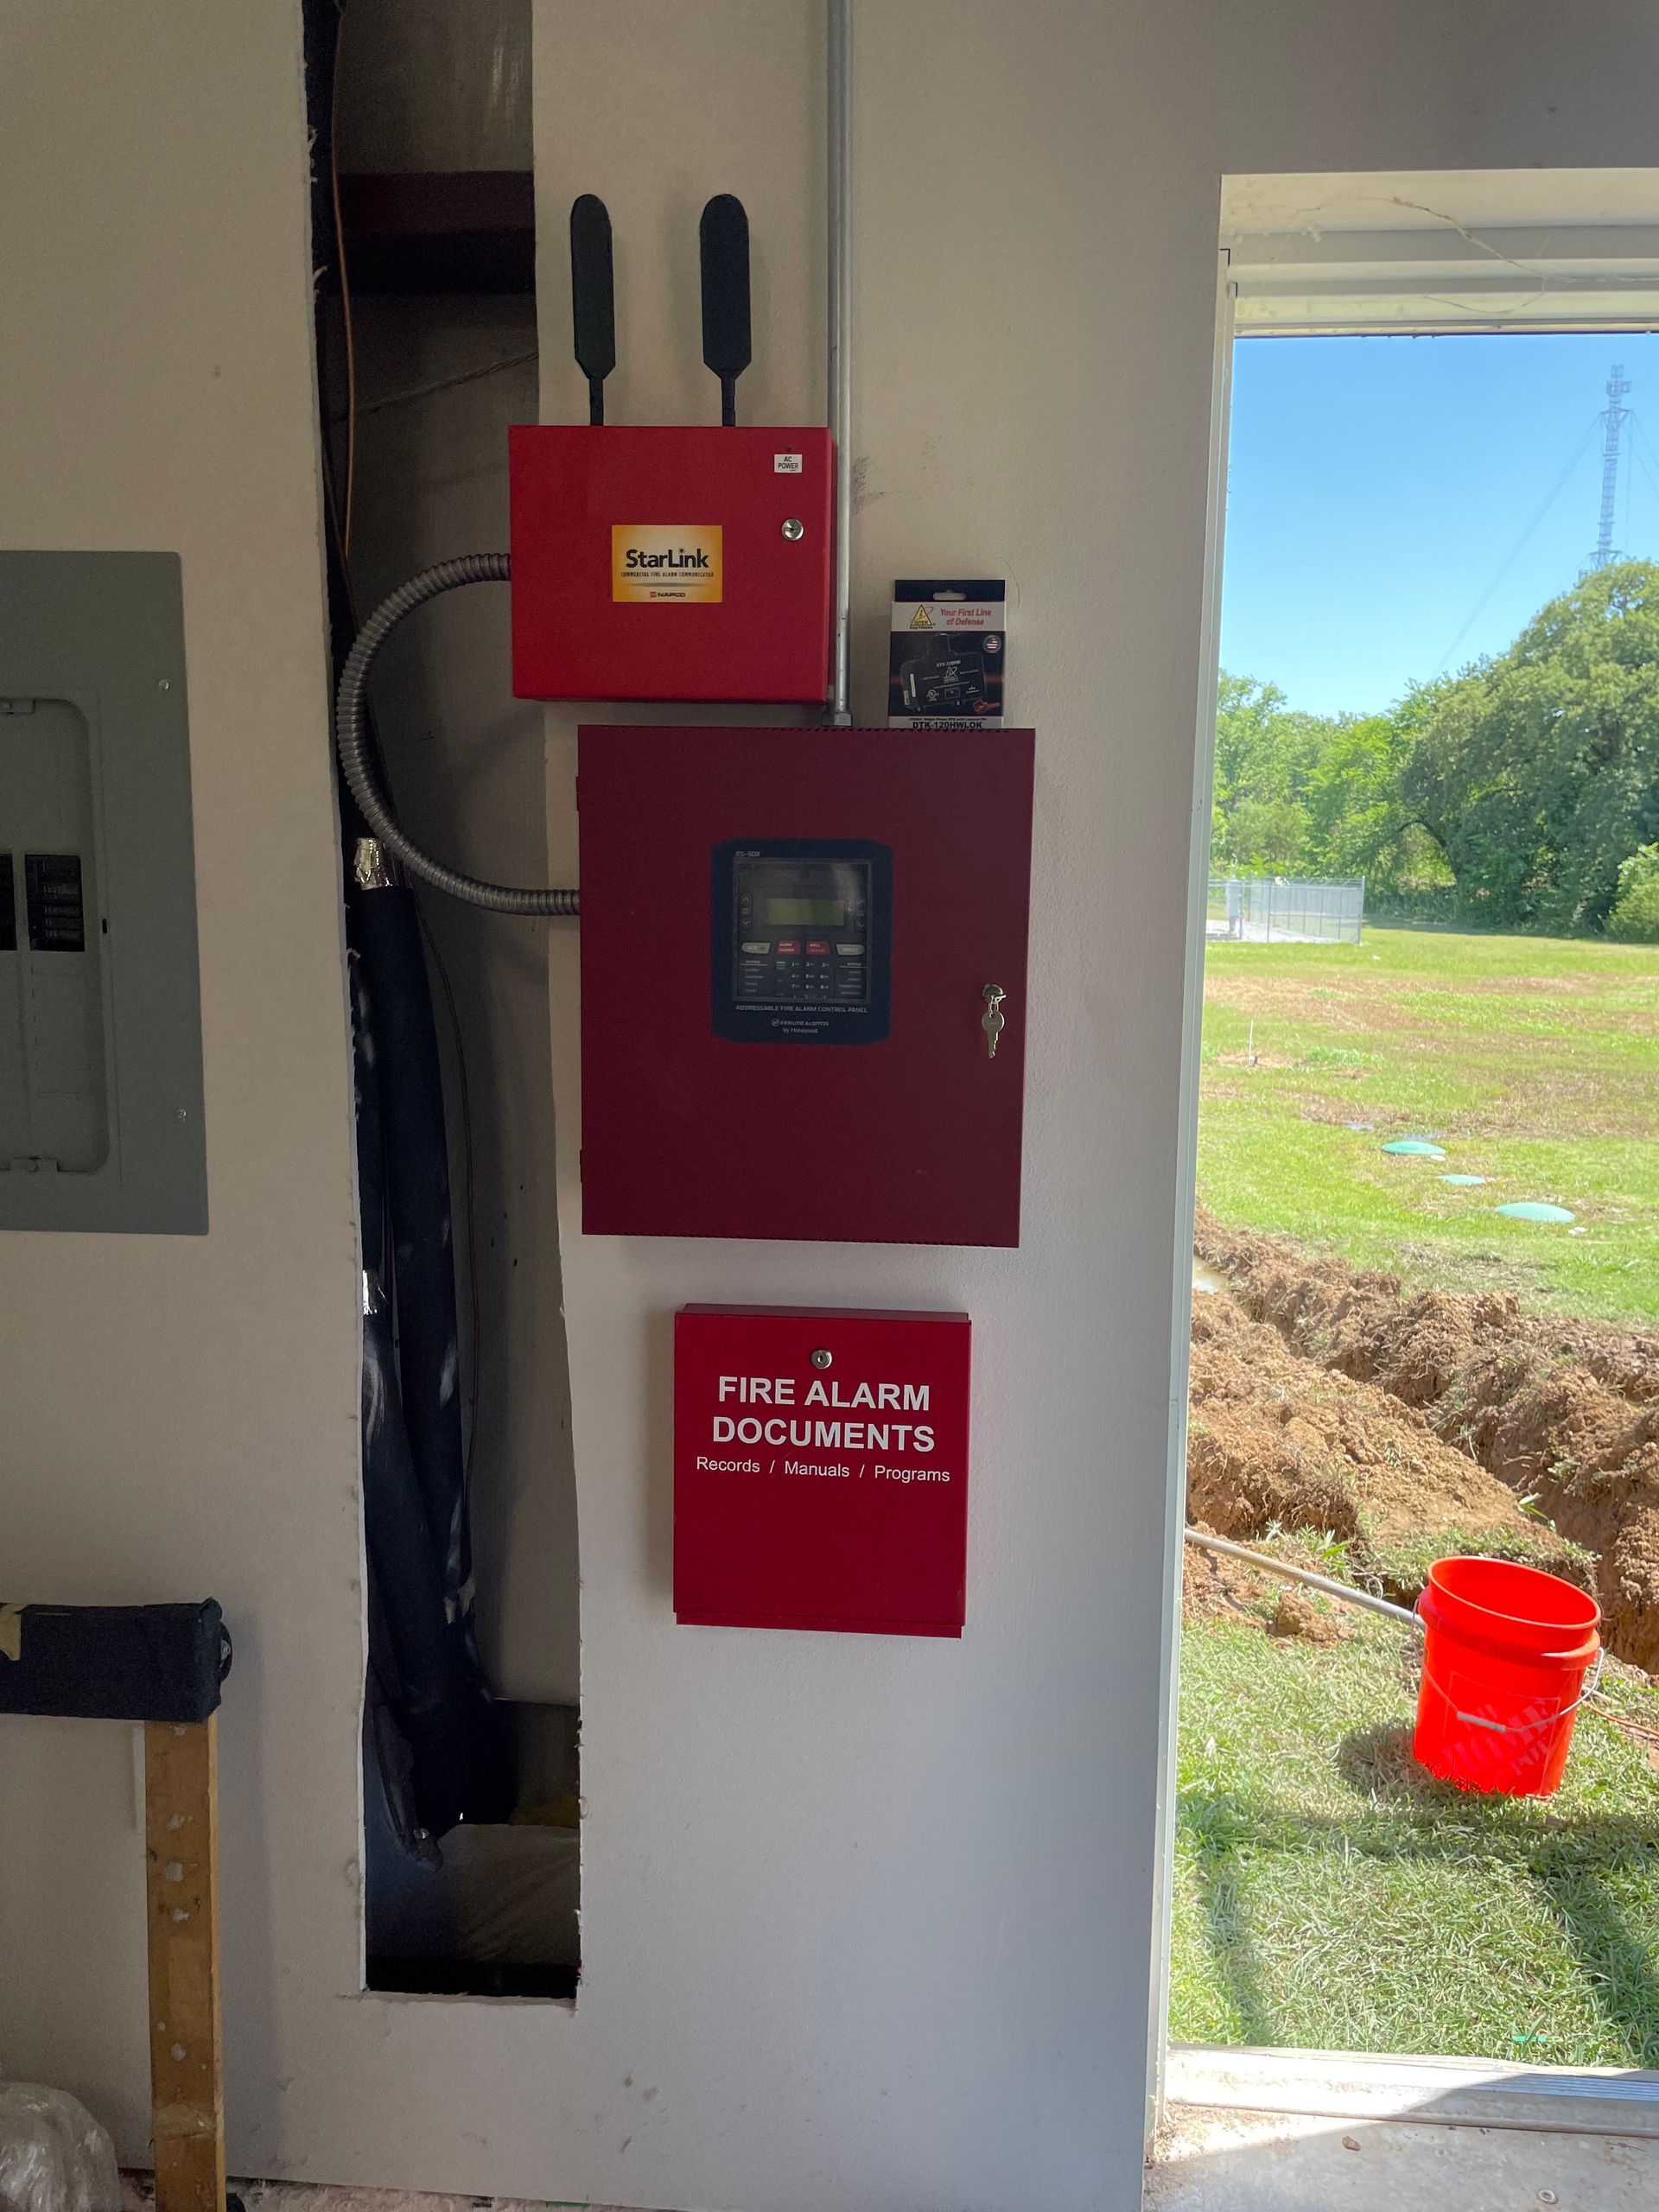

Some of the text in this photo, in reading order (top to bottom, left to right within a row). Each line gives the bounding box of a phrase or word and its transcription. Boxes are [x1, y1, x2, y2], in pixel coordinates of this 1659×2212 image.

[626, 548, 709, 569] StarLink
[940, 608, 992, 617] Your First Line
[718, 1375, 930, 1412] FIRE ALARM
[712, 1416, 935, 1452] DOCUMENTS
[696, 1456, 951, 1484] Records / Manuals / Programs
